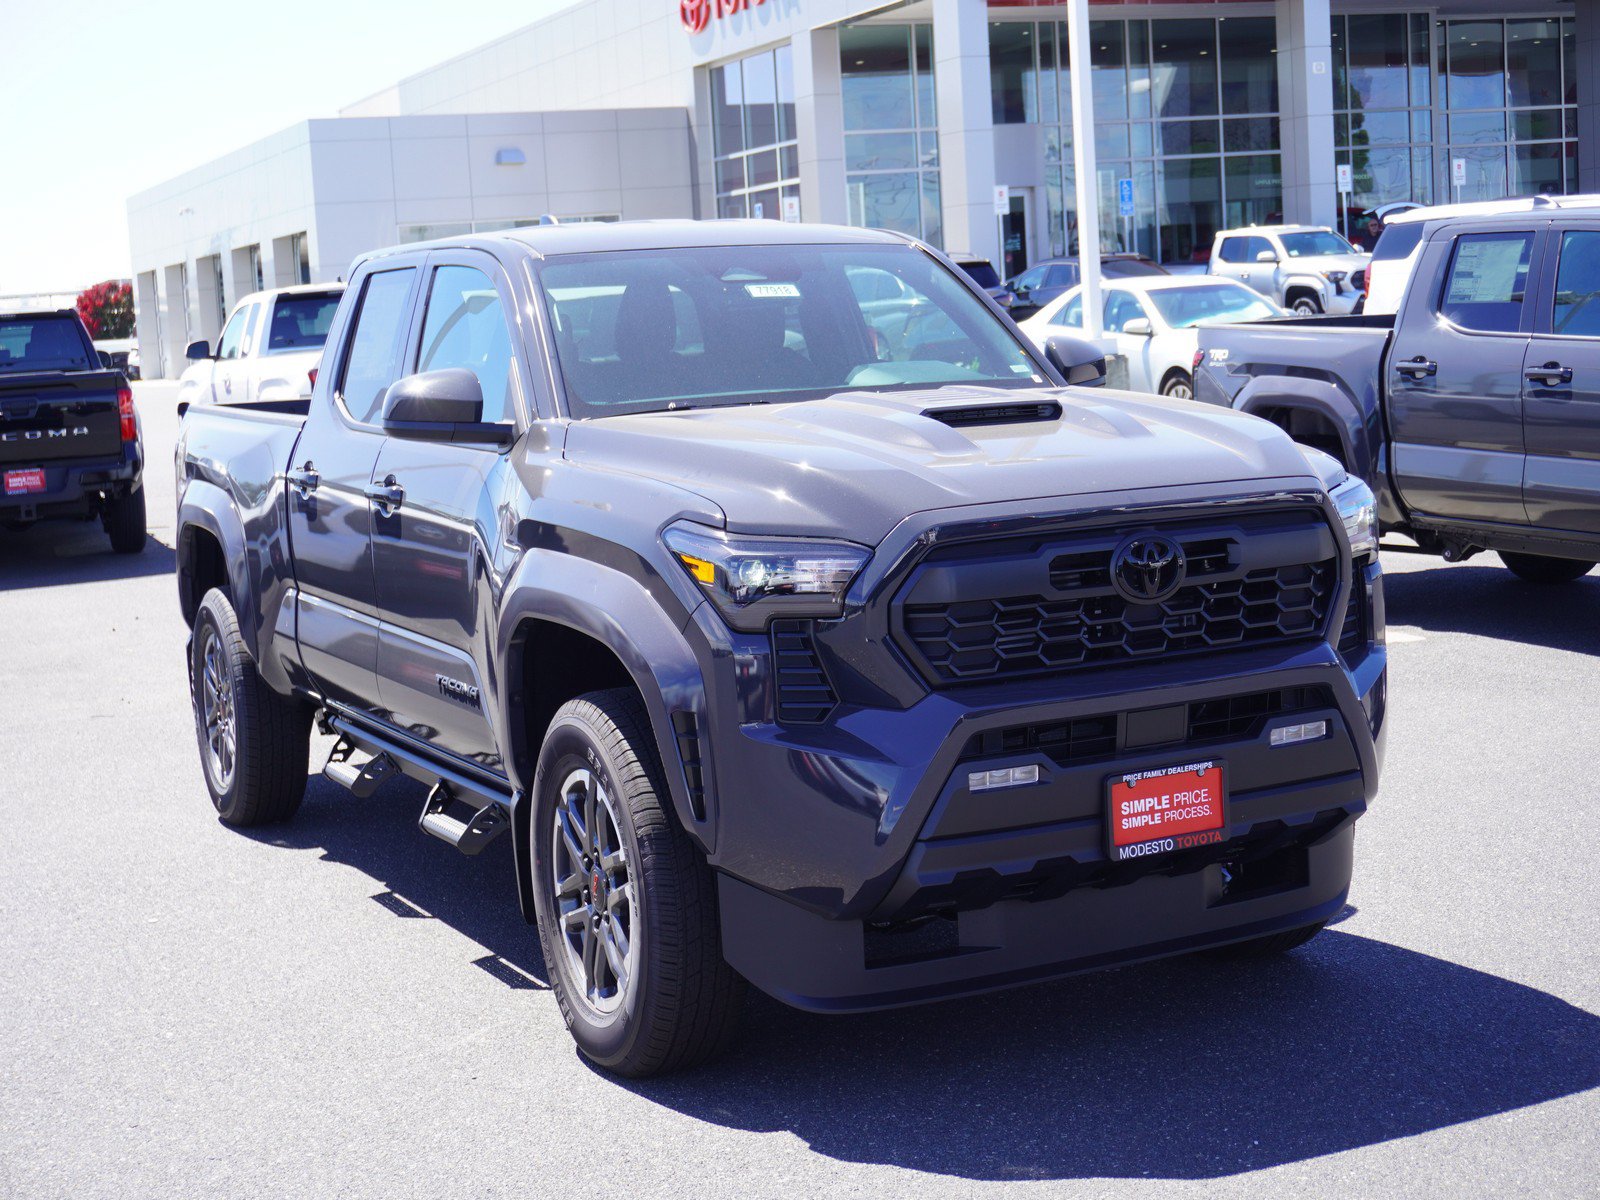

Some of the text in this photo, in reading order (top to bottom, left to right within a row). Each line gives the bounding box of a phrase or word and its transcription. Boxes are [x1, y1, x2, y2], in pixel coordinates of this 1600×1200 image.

[1209, 349, 1229, 361] TRD
[435, 673, 479, 700] TACOMA
[1122, 761, 1213, 782] PRICE FAMILY DEALERSHIPS
[1121, 788, 1212, 815] SIMPLE PRICE.
[1121, 804, 1213, 829] SIMPLE PROCESS.
[1119, 831, 1222, 860] MODESTO TOYOTA
